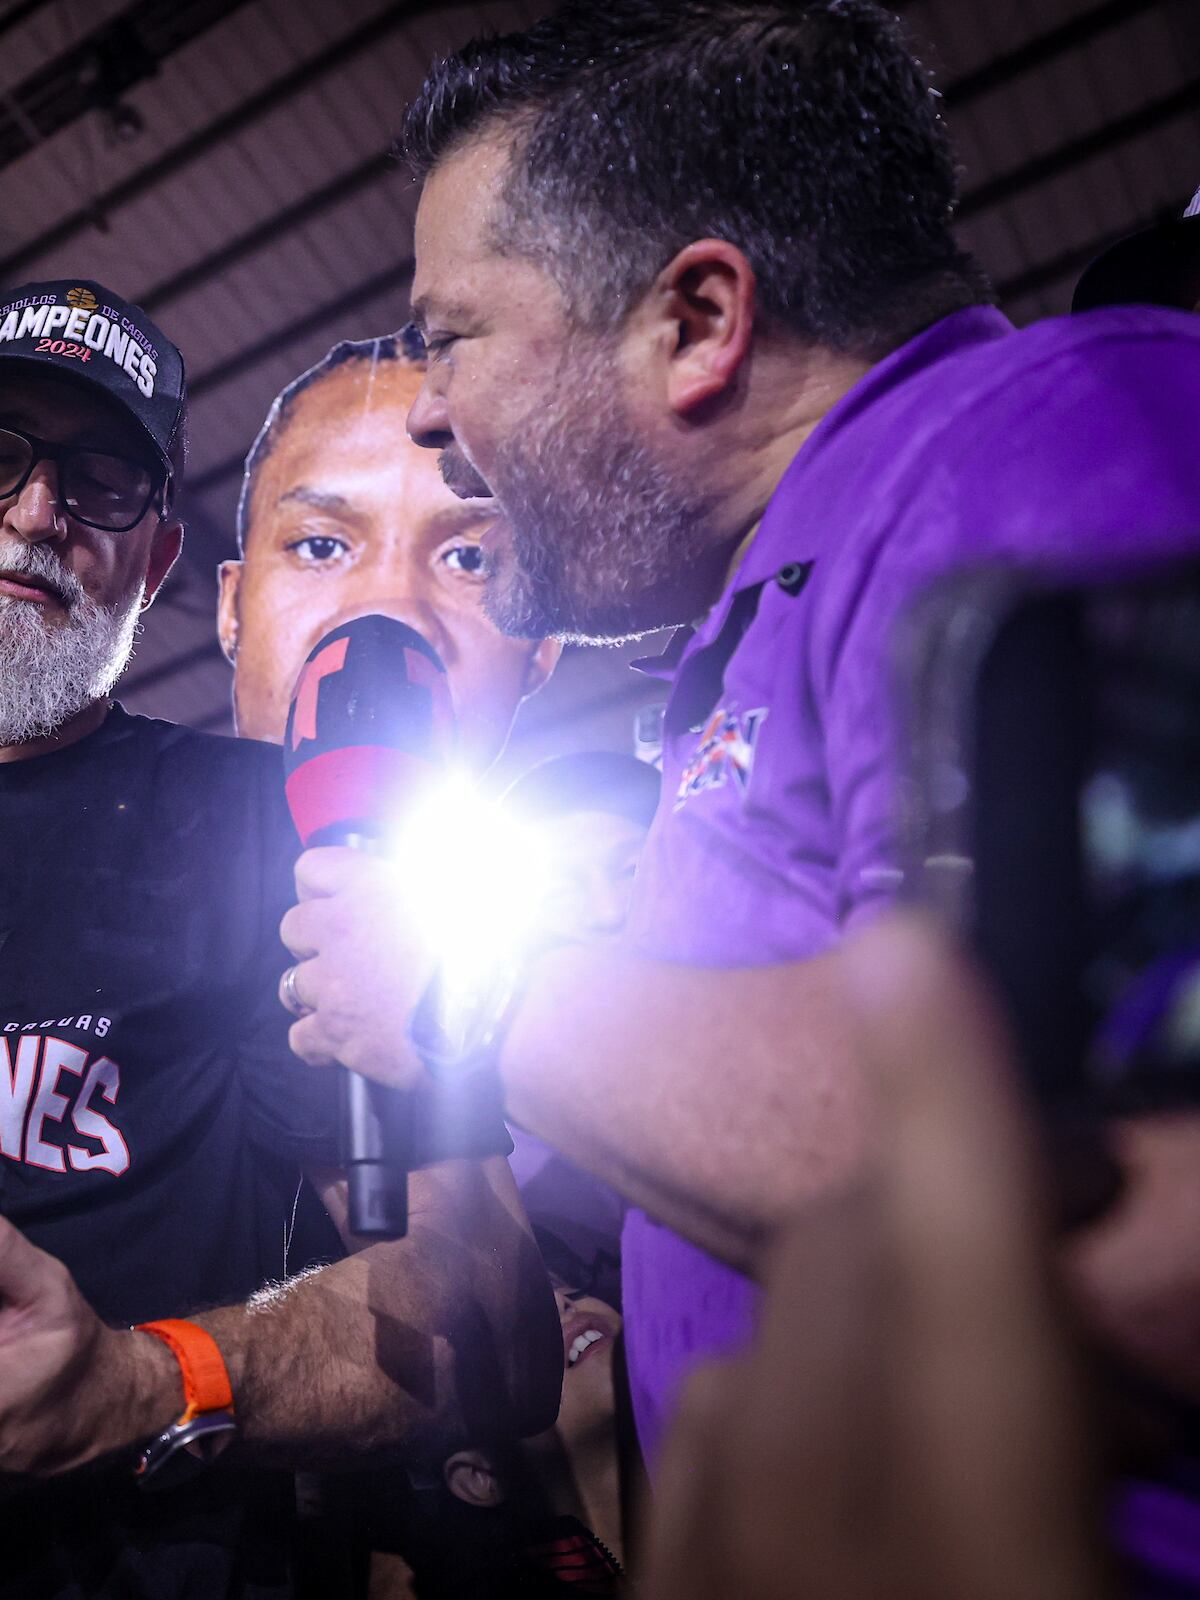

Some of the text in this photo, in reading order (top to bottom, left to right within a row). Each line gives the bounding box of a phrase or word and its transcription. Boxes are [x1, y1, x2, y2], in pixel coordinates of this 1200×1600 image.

[101, 304, 119, 322] DE
[121, 316, 159, 361] CAGUAS
[34, 338, 93, 363] 2024
[3, 1014, 112, 1038] CAGUAS
